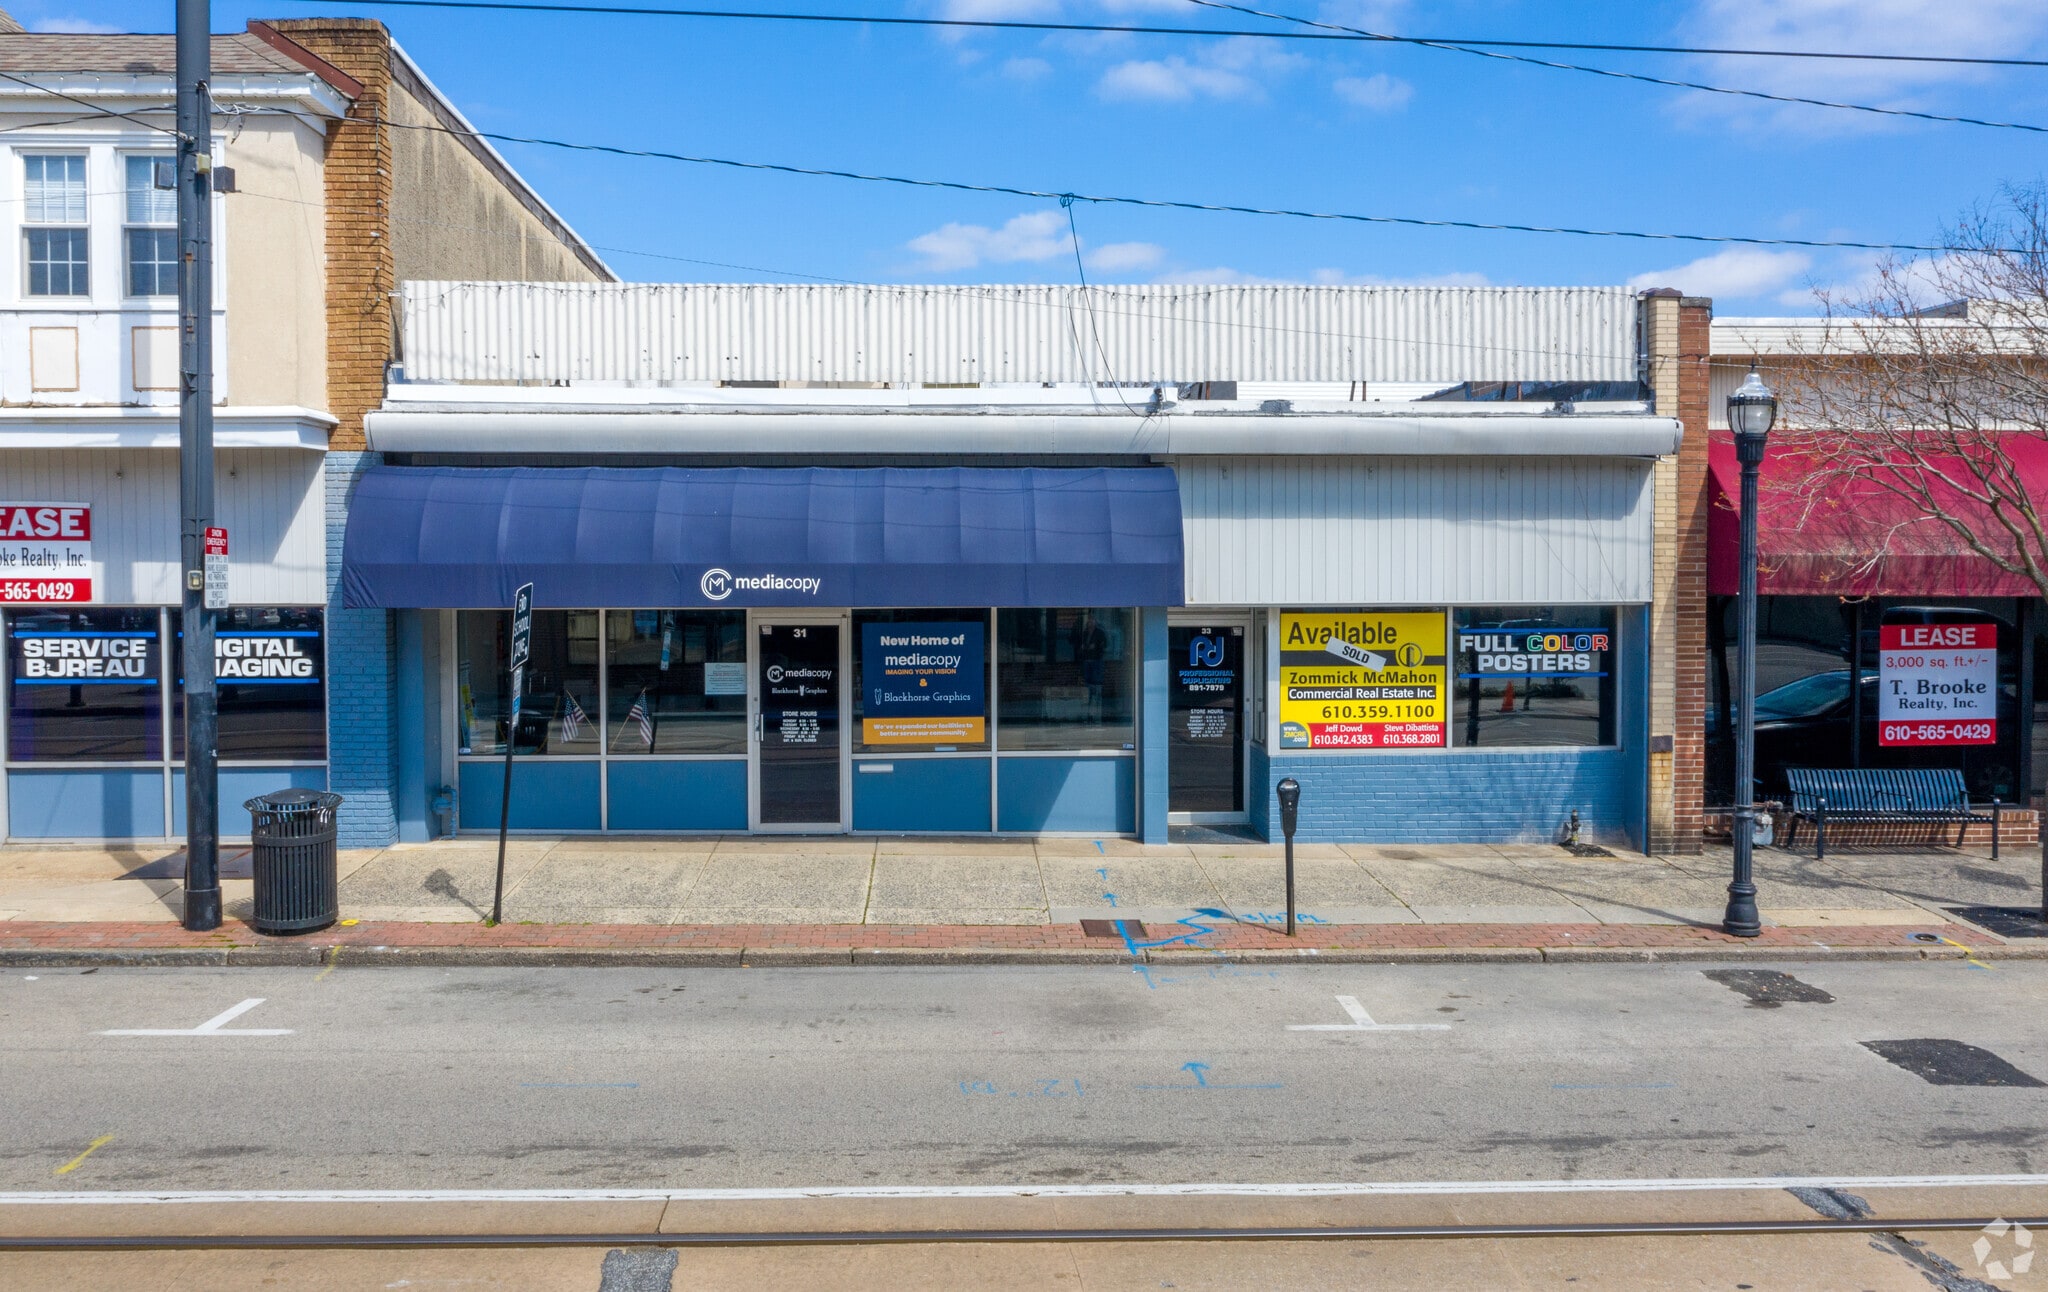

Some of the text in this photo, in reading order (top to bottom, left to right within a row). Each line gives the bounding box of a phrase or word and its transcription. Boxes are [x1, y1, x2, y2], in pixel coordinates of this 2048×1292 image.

[21, 547, 62, 570] Realty,
[66, 547, 87, 567] Inc.
[735, 574, 821, 595] mediacopy
[793, 628, 807, 638] 31
[1201, 627, 1212, 635] 33
[1287, 621, 1398, 645] Available
[1900, 627, 1977, 646] LEASE
[880, 634, 965, 646] New Home of
[1459, 634, 1609, 653] FULL COLOR
[23, 639, 147, 658] SERVICE
[215, 638, 303, 657] IGITAL
[1342, 645, 1370, 664] SOLD
[885, 653, 961, 668] mediacopy
[1477, 654, 1591, 672] POSTERS
[1886, 656, 1924, 670] 3,000
[1929, 658, 1949, 670] sq.
[785, 668, 832, 680] mediacopy
[1289, 671, 1437, 684] Zommick McMahon
[919, 678, 928, 687] &
[1889, 679, 1987, 695] T. Brooke
[884, 691, 971, 703] Blackhorse Graphics
[1288, 687, 1436, 699] Commercial Real Estate Inc.
[1898, 697, 1978, 711] Realty, Inc.
[1322, 705, 1435, 719] 610.359.1100
[1325, 724, 1363, 733] Jeff Dowd
[1384, 724, 1404, 733] Steve
[1884, 723, 1991, 740] 610-565-0429
[1314, 734, 1373, 745] 610.842.4383
[1383, 734, 1440, 744] 610.368.2801
